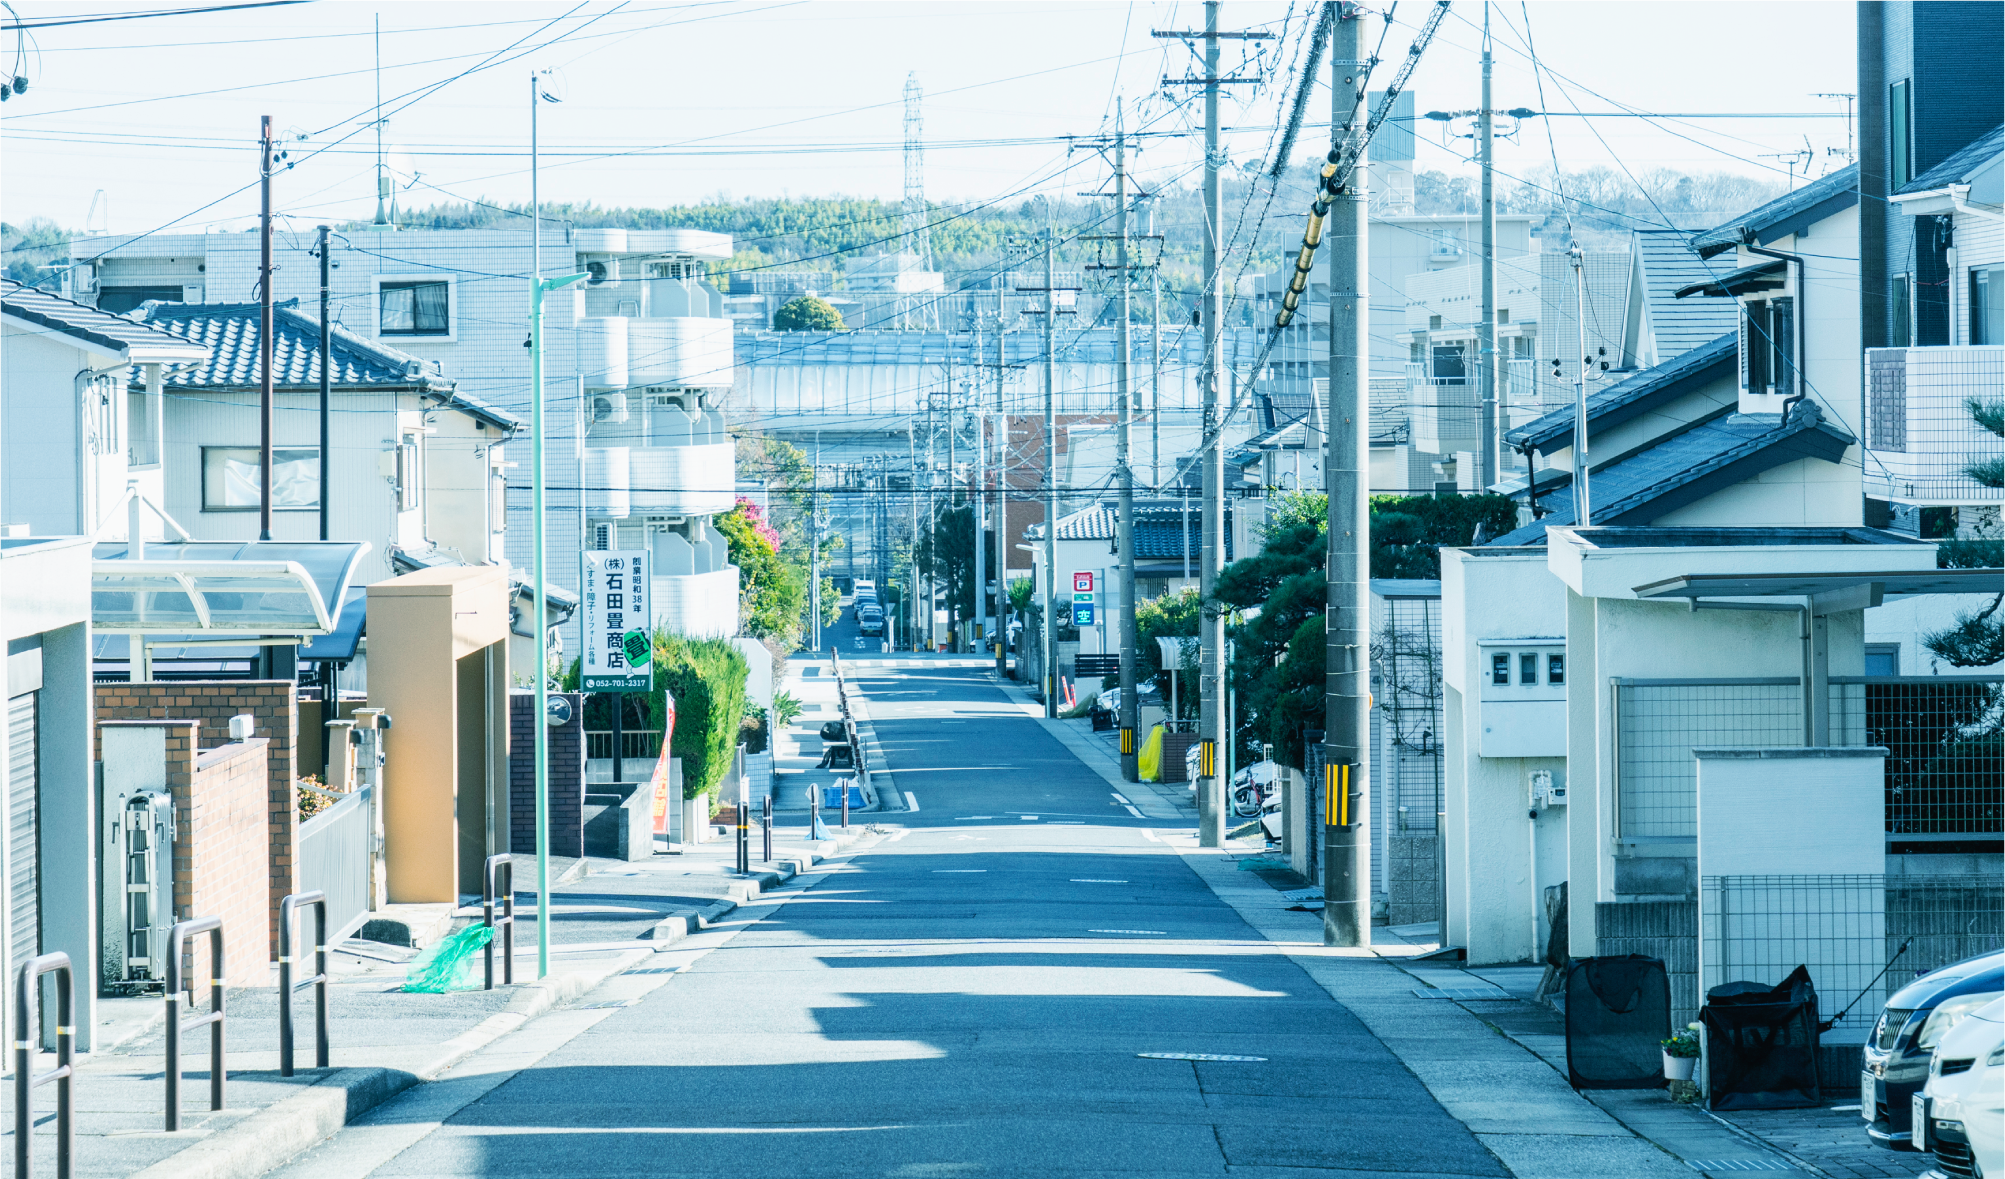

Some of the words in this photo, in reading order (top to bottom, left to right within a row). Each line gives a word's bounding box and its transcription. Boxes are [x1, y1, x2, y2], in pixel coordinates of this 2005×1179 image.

[632, 557, 643, 613] 創業昭和38年
[604, 558, 624, 668] (株)石田畳商店
[1077, 610, 1090, 623] 空
[595, 679, 646, 687] 052-701-2317
